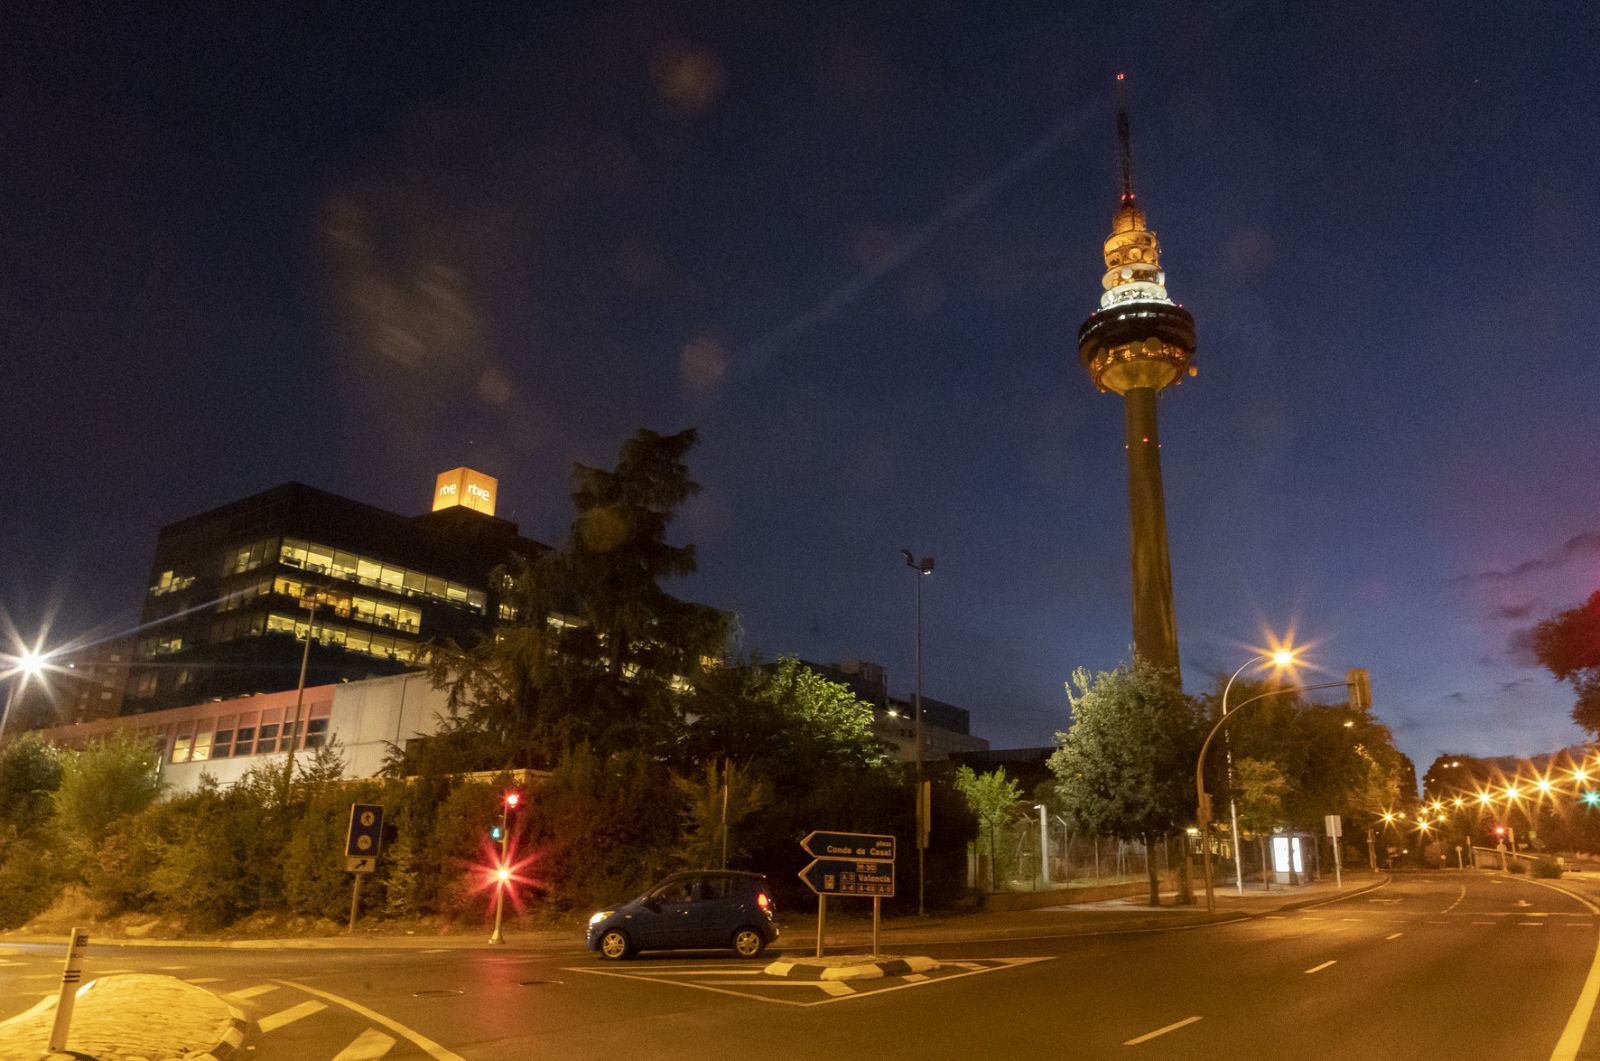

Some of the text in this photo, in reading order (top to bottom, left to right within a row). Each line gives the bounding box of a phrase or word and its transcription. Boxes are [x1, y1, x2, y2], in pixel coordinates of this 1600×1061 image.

[439, 483, 457, 496] rtve
[467, 483, 490, 502] rtve
[826, 845, 892, 857] Conde de Casal
[858, 873, 891, 883] Valencia
